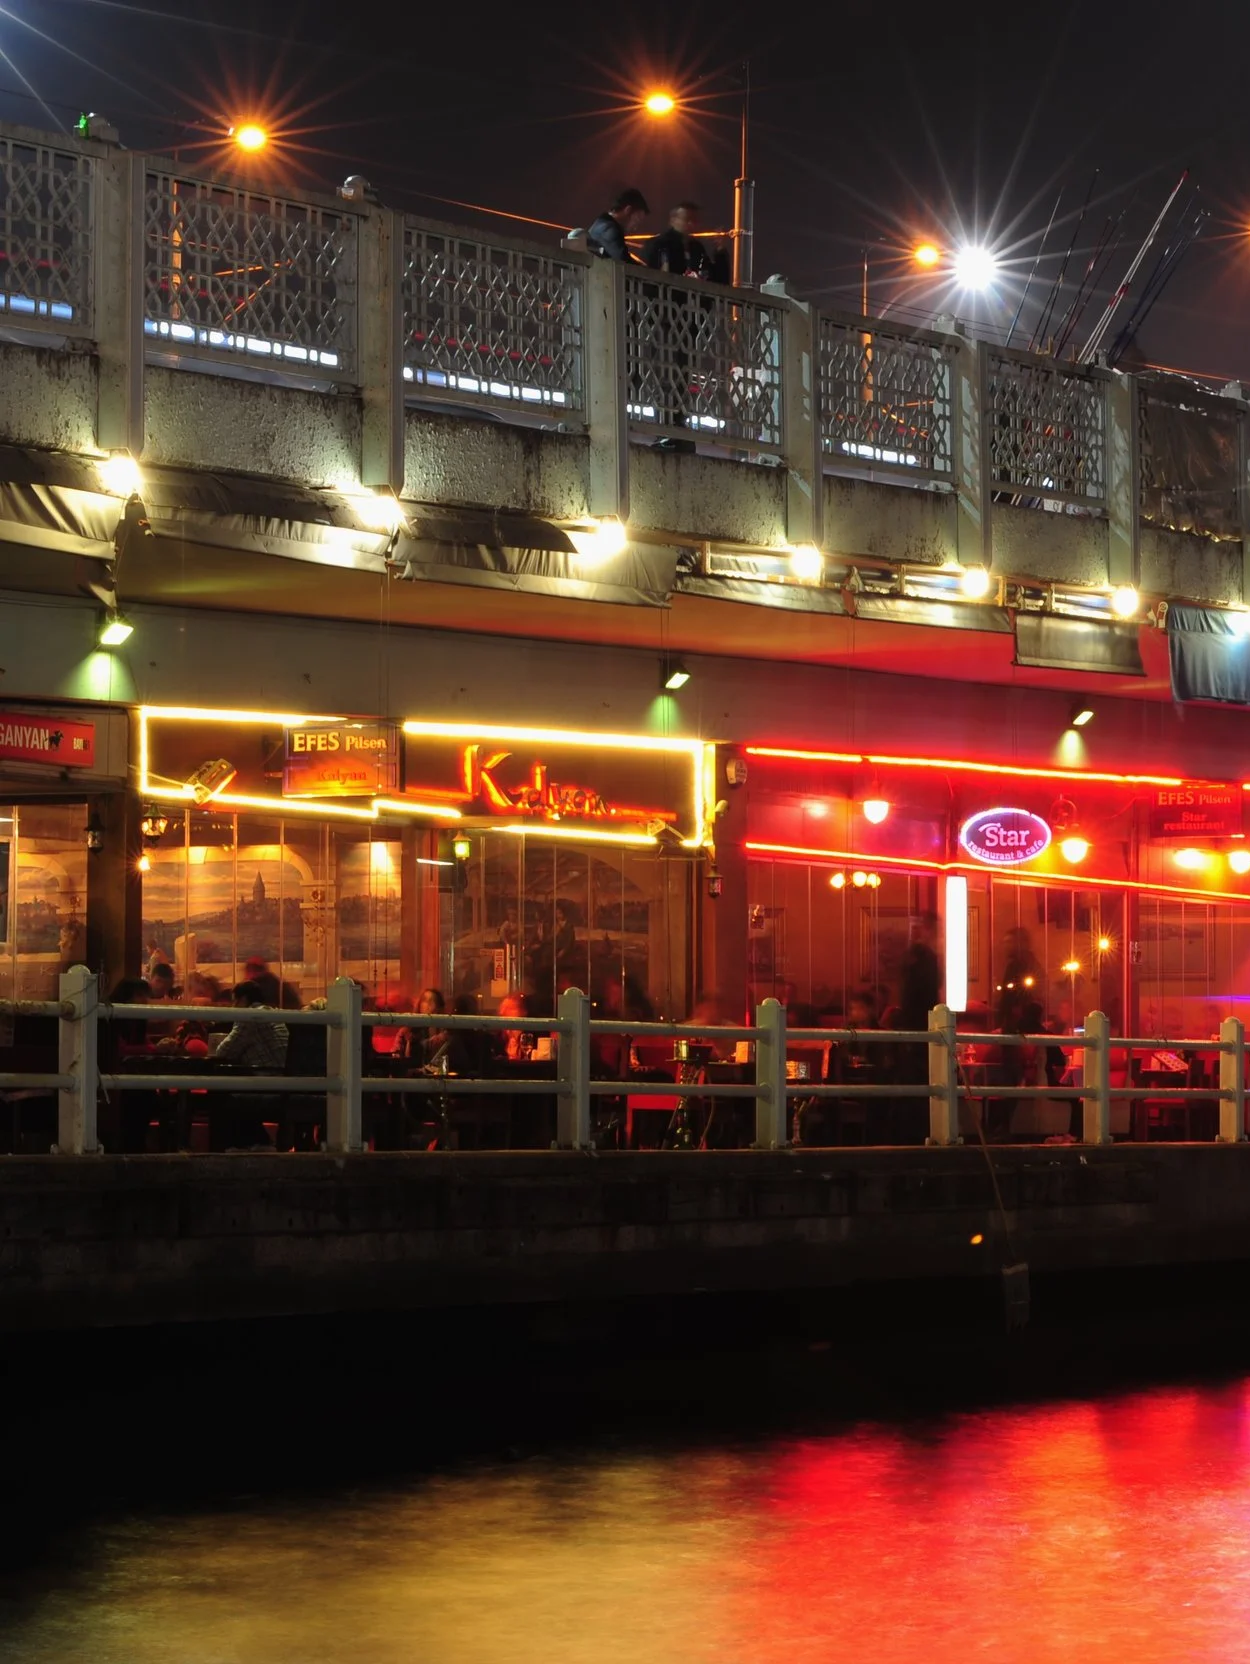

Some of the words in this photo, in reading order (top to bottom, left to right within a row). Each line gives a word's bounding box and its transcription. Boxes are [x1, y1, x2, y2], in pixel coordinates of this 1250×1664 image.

[293, 732, 340, 752] EFES
[345, 735, 387, 751] Pilsen
[1158, 791, 1195, 806] EFES
[1199, 793, 1231, 805] Pilsen
[1182, 811, 1207, 822] Star
[978, 822, 1030, 847] Star
[967, 840, 1014, 861] restaurant
[1016, 849, 1025, 859] &
